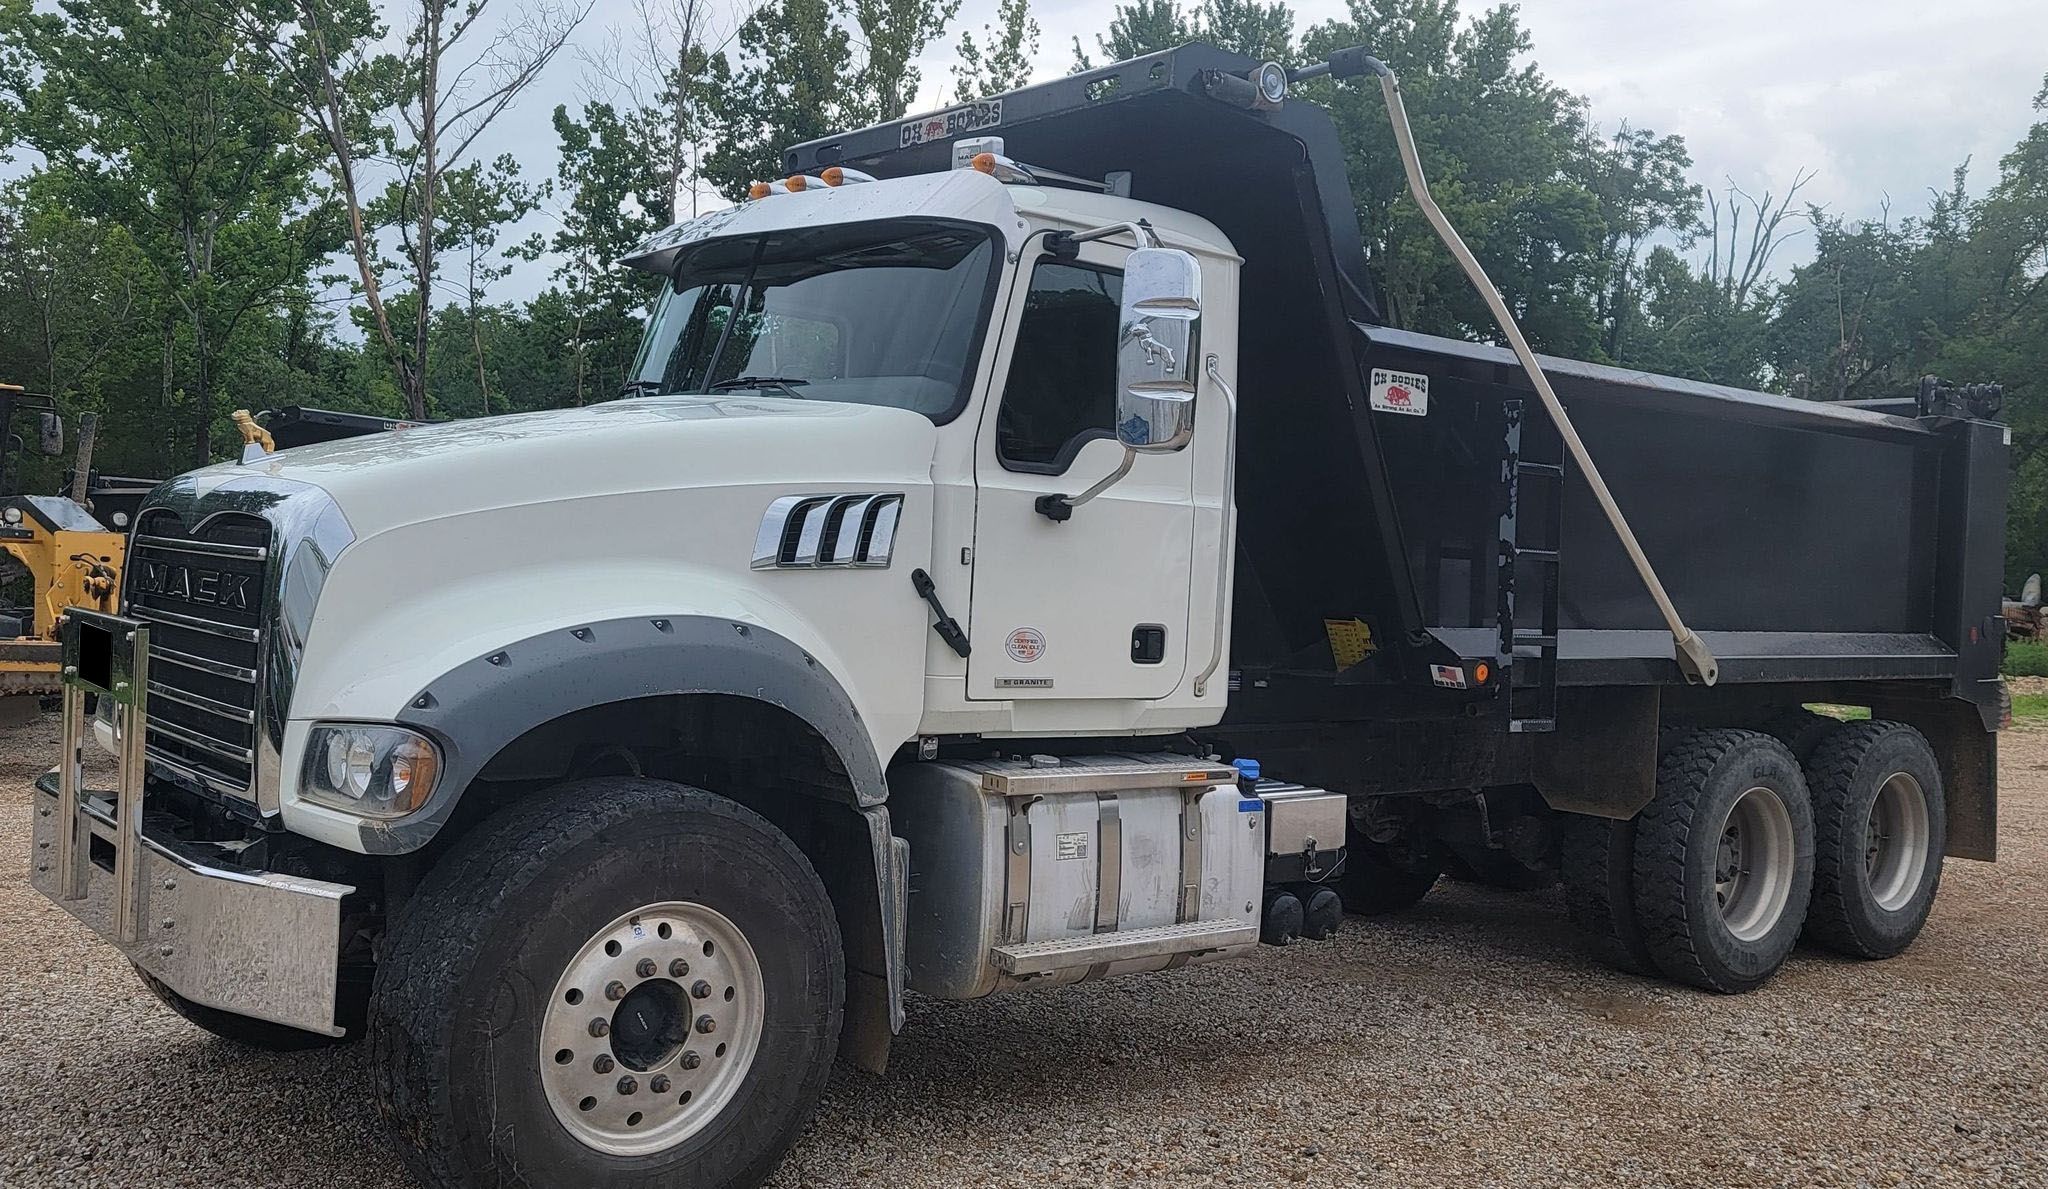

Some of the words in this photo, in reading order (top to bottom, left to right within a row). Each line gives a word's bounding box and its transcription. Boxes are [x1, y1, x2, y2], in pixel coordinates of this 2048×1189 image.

[1374, 372, 1387, 386] OX
[1391, 374, 1427, 393] BODIES
[140, 561, 250, 608] MACK
